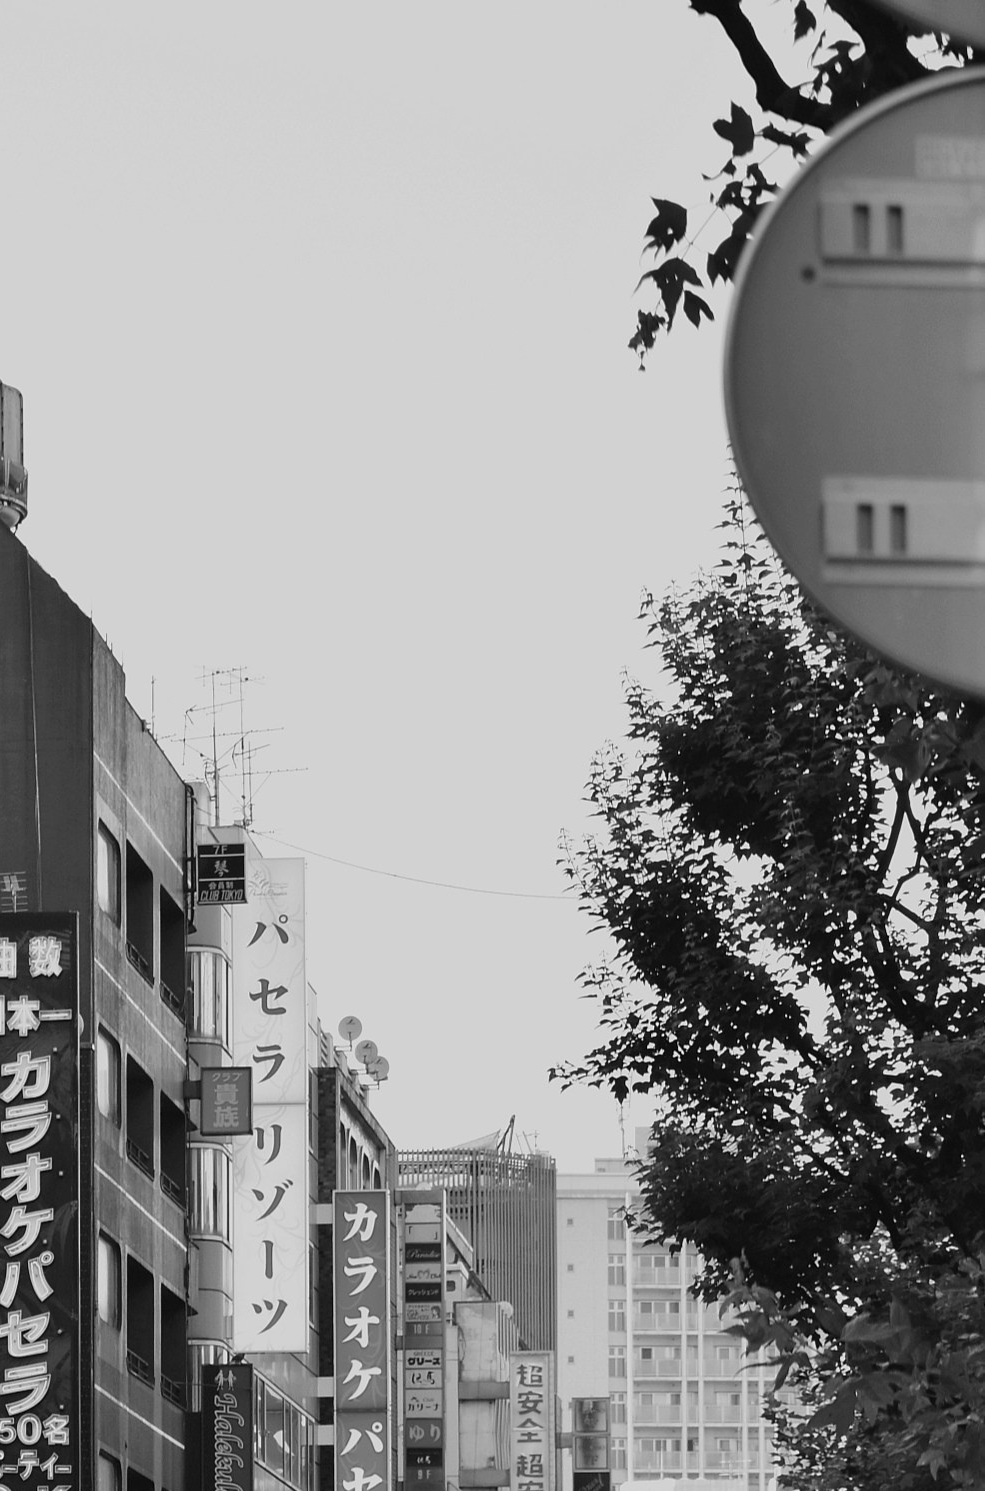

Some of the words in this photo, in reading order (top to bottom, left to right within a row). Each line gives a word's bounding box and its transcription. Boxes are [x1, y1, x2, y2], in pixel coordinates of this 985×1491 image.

[213, 845, 228, 855] 7F
[200, 890, 219, 901] CLUB
[221, 889, 243, 900] TOKYO
[211, 1072, 243, 1081] クラブ
[213, 1084, 239, 1128] 貴族
[516, 1363, 544, 1443] 超安全
[409, 1424, 442, 1442] ゆり
